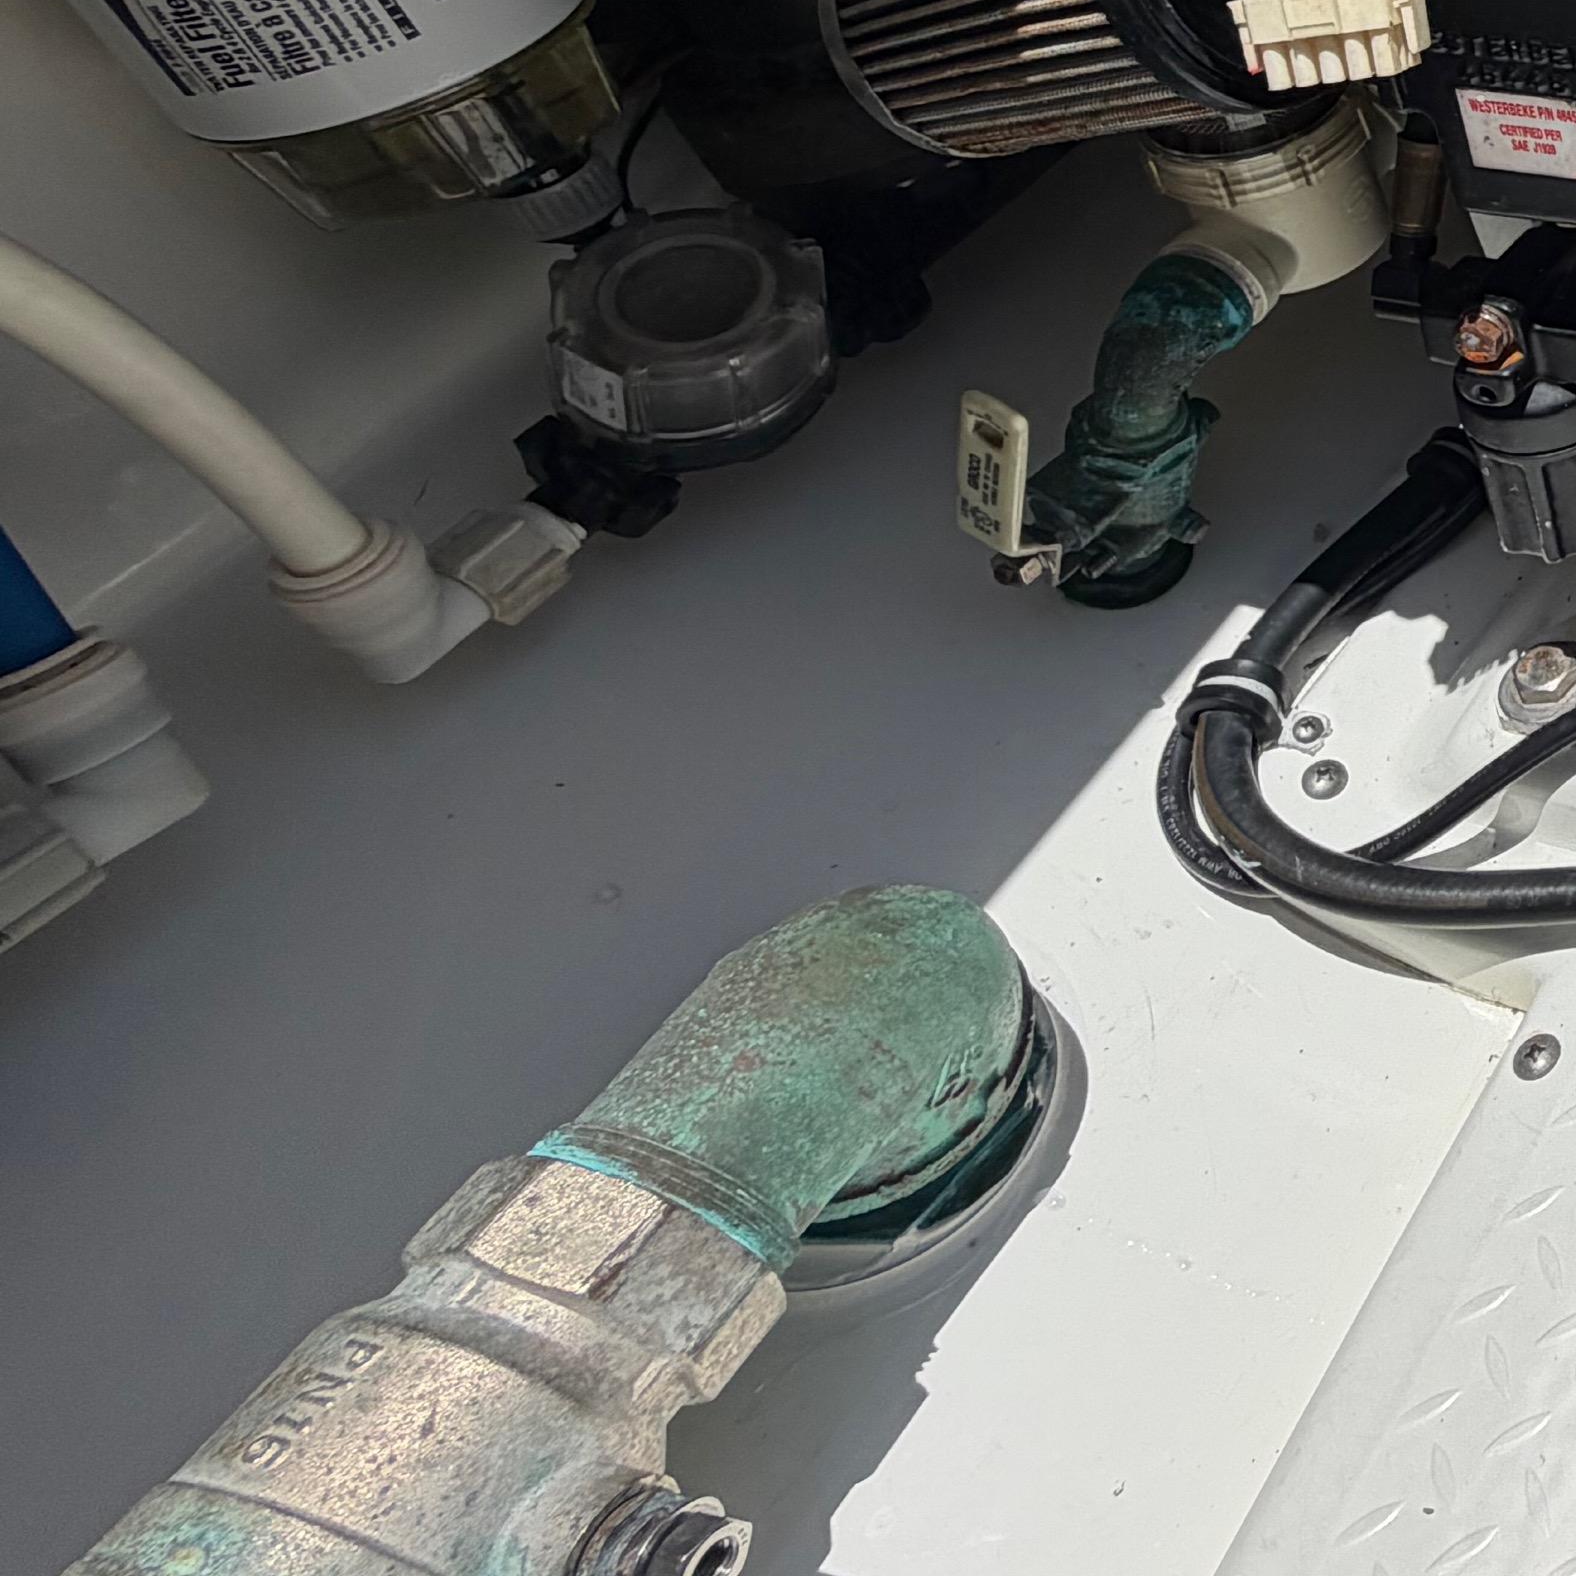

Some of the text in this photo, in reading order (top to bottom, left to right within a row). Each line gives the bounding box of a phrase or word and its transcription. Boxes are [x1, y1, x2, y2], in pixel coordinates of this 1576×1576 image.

[253, 14, 285, 31] à
[266, 29, 322, 77] Filtre
[196, 40, 255, 91] Fuel
[1468, 98, 1536, 118] WESTERBEKE
[1499, 123, 1563, 142] CERTIFIED PER
[1511, 138, 1530, 152] SAE
[238, 1333, 384, 1475] PN16
